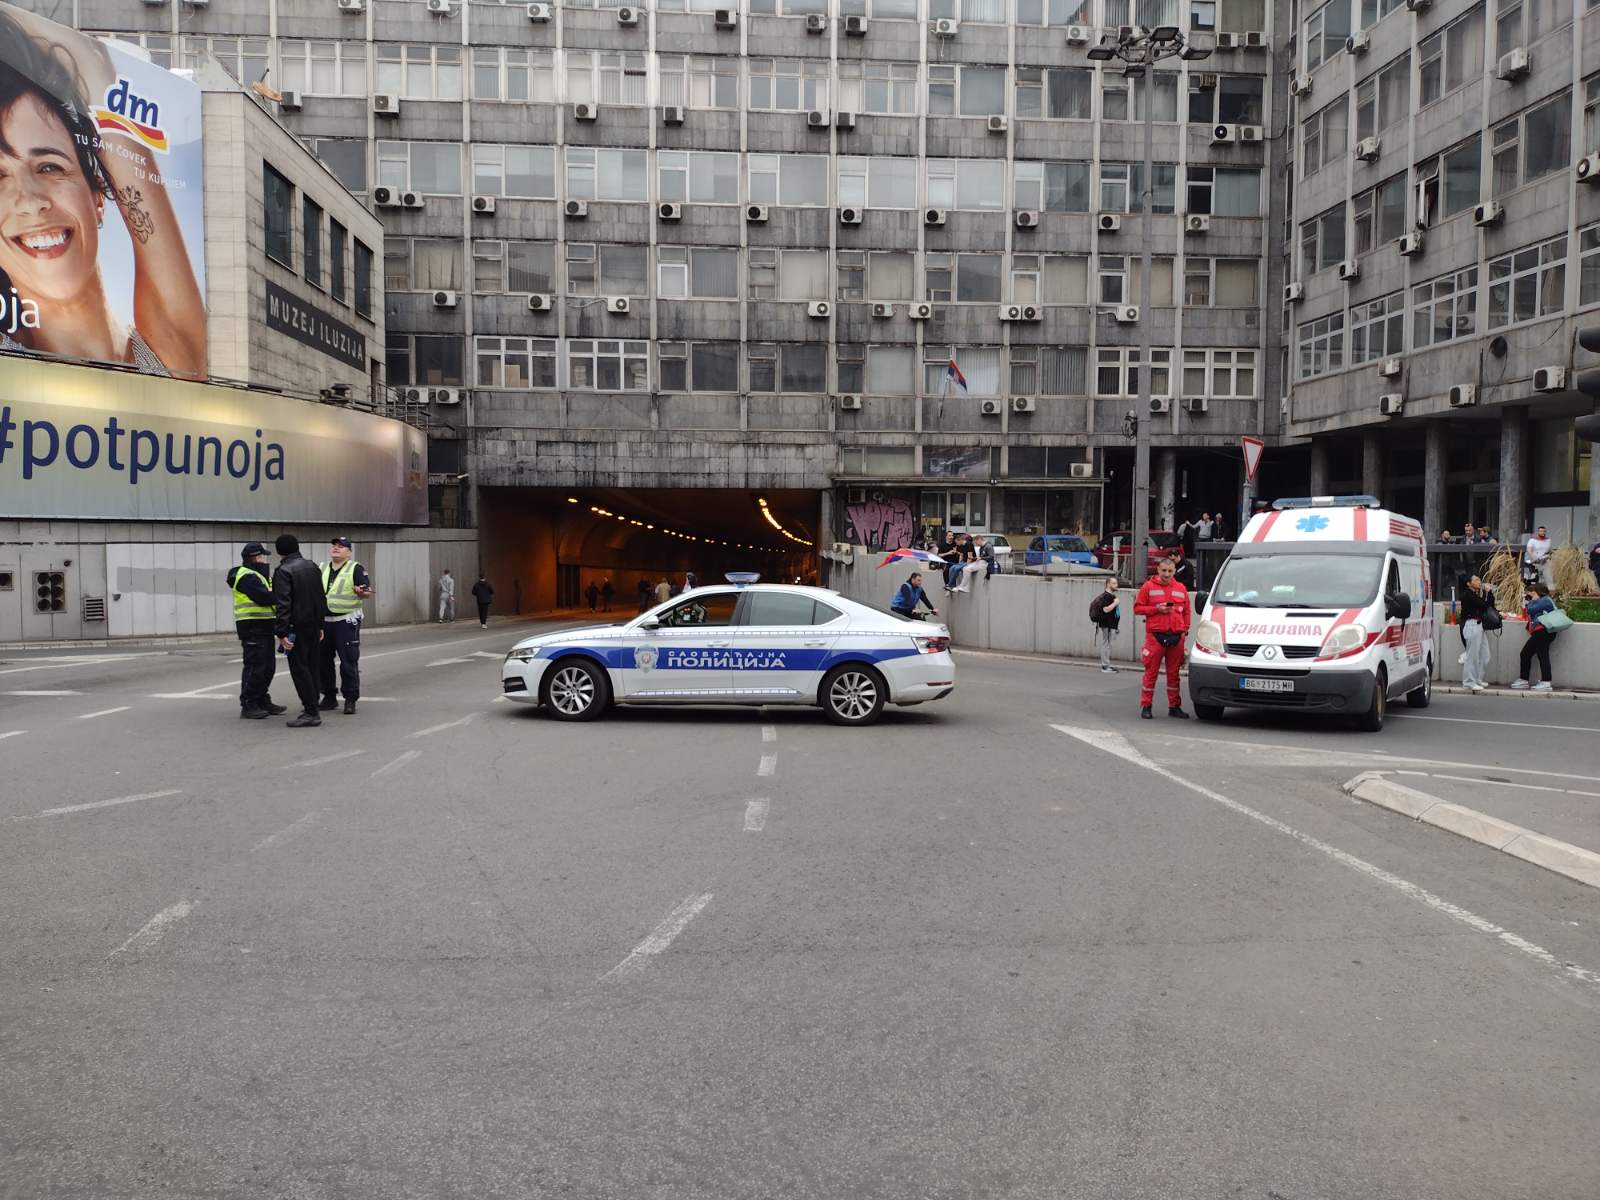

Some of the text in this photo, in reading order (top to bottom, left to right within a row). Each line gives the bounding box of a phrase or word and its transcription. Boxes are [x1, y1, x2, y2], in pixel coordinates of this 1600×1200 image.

[107, 79, 158, 127] dm
[74, 133, 88, 145] TU
[92, 137, 113, 153] SAM
[134, 166, 186, 189] TU KUPEM
[269, 294, 363, 361] MUZEJ ILUZIJA
[668, 657, 786, 669] ПОЛИЦИЈА
